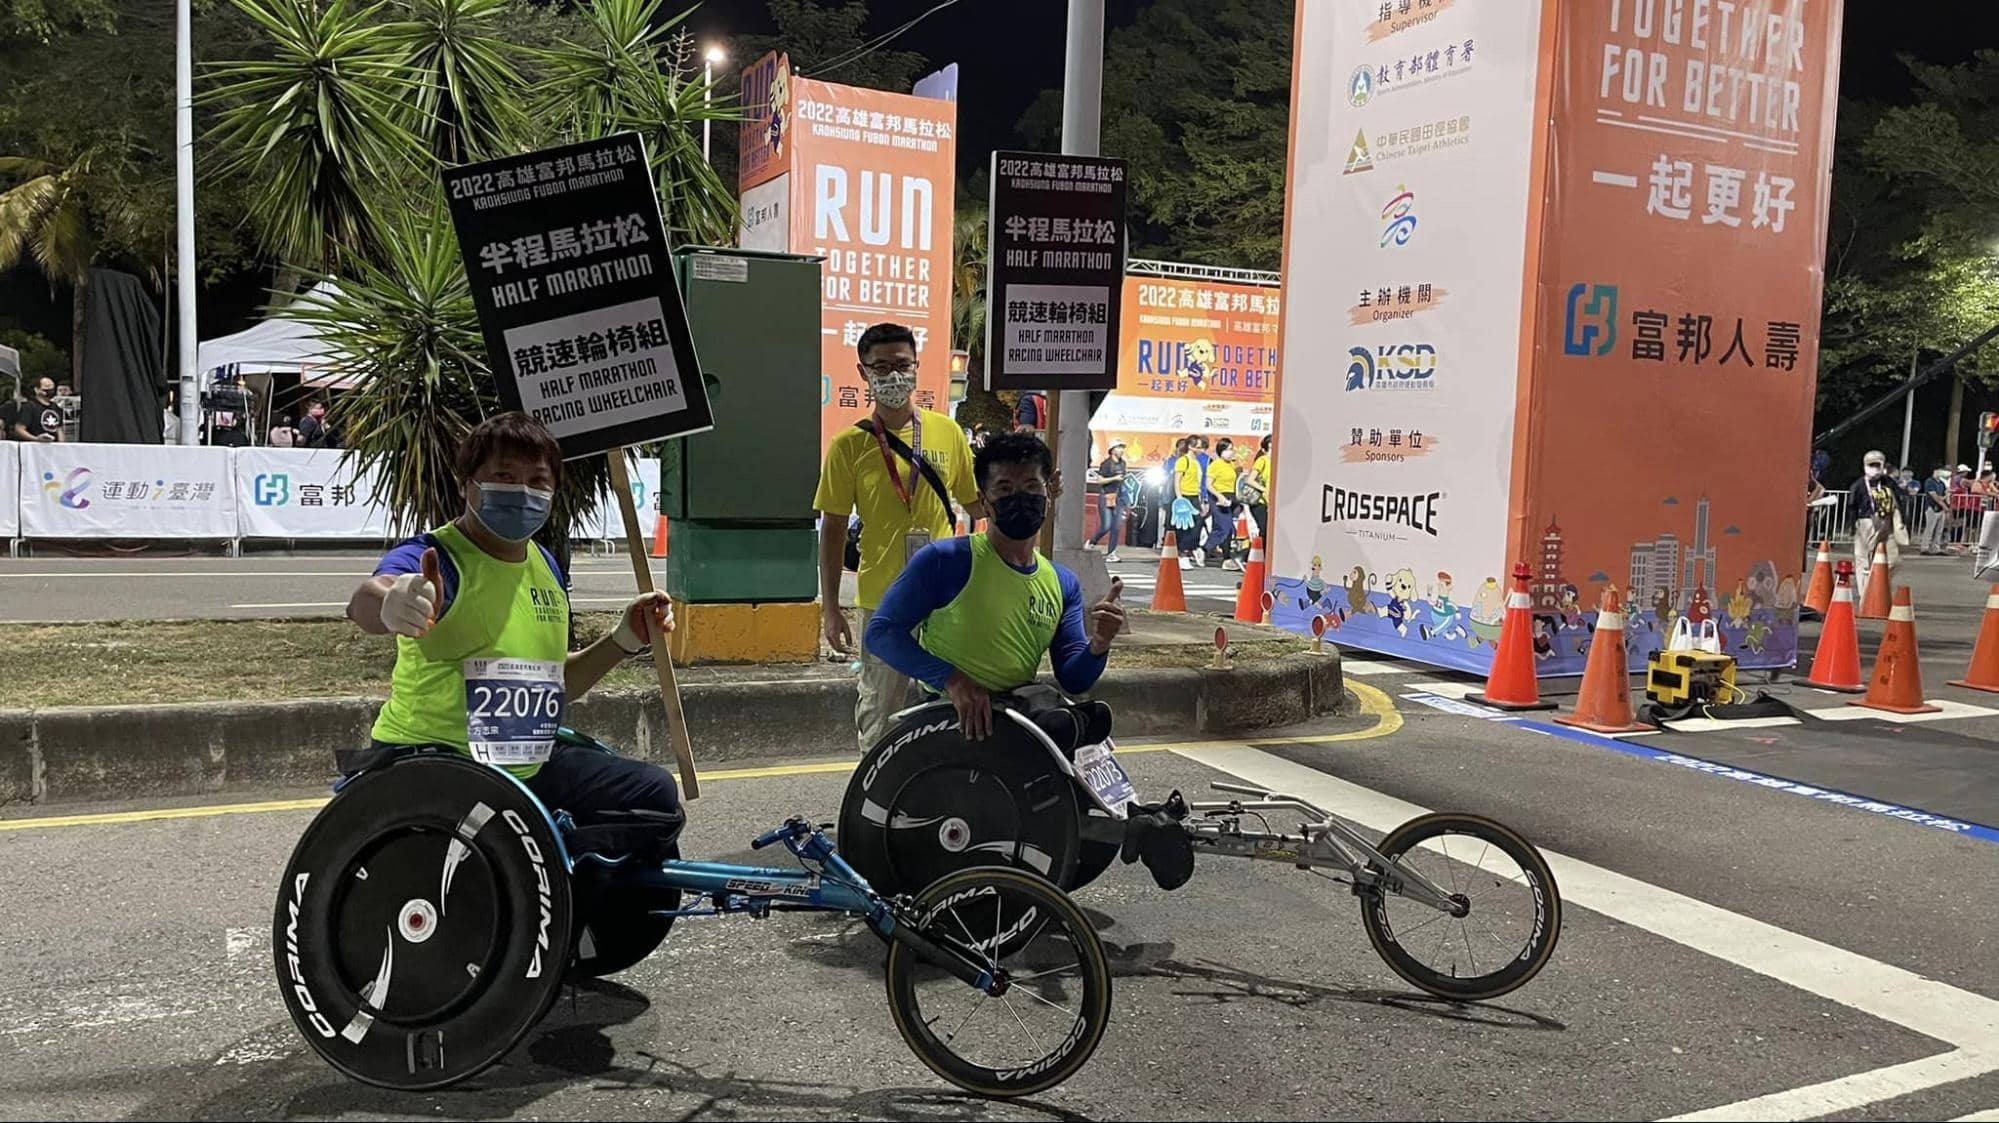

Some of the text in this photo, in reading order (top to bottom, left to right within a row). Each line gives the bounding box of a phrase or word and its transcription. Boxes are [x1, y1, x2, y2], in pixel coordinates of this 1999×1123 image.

[1378, 0, 1447, 23] 指導
[1390, 11, 1438, 34] Supervisor
[1376, 39, 1475, 85] 教育部體育署
[1600, 43, 1801, 132] FOR BETTER
[797, 99, 952, 139] 2022高雄富邦馬拉松
[1377, 116, 1470, 147] 中華民國田徑協會
[812, 122, 938, 152] KAOHSIUNG FUBON MARATHON
[1407, 143, 1431, 156] Taipei
[1433, 135, 1469, 151] Athletics
[450, 143, 638, 200] 2022高雄富邦馬拉松
[1000, 159, 1123, 182] 2022高雄富邦馬拉松
[473, 168, 625, 211] KAOHSIUNG FUBON MARATHON
[1051, 180, 1073, 191] FUBON
[1074, 182, 1112, 193] MARATHON
[1592, 154, 1796, 233] 一起更好
[814, 164, 933, 251] RUN
[480, 212, 650, 275] 半程馬拉松
[1005, 215, 1117, 245] 半程馬拉松
[1006, 249, 1112, 271] HALF MARATHON
[491, 276, 539, 309] HALF
[545, 253, 654, 298] MARATHON
[822, 275, 929, 308] OR BETTER
[1358, 283, 1432, 309] 主辦機關
[1008, 301, 1107, 325] 競速輪椅組
[1373, 309, 1414, 323] Organizer
[513, 318, 670, 378] 競速輪椅組
[1018, 329, 1094, 344] HALF MARATHON
[1631, 309, 1801, 372] 富邦人壽
[1008, 349, 1103, 363] RACING WHEELCHAIR
[1376, 344, 1437, 380] KSD
[539, 358, 658, 400] HALF MARATHON
[1138, 379, 1188, 393] 一起更好
[1246, 369, 1276, 389] BET
[532, 378, 679, 426] RACING WHEELCHAIR
[1364, 449, 1405, 463] Sponsors
[1321, 483, 1440, 537] CROSSPACE
[1358, 530, 1396, 542] TITANIUM
[1029, 595, 1057, 618] RUN
[474, 686, 559, 718] 22076
[475, 743, 491, 761] H
[1086, 760, 1122, 791] 22073
[502, 809, 553, 978] CORIMA
[727, 878, 772, 891] SPEED
[918, 885, 998, 931] ORIMA
[1520, 869, 1545, 960] CORIMA
[286, 872, 337, 1038] CORIMA
[995, 1015, 1087, 1082] CORIMA
